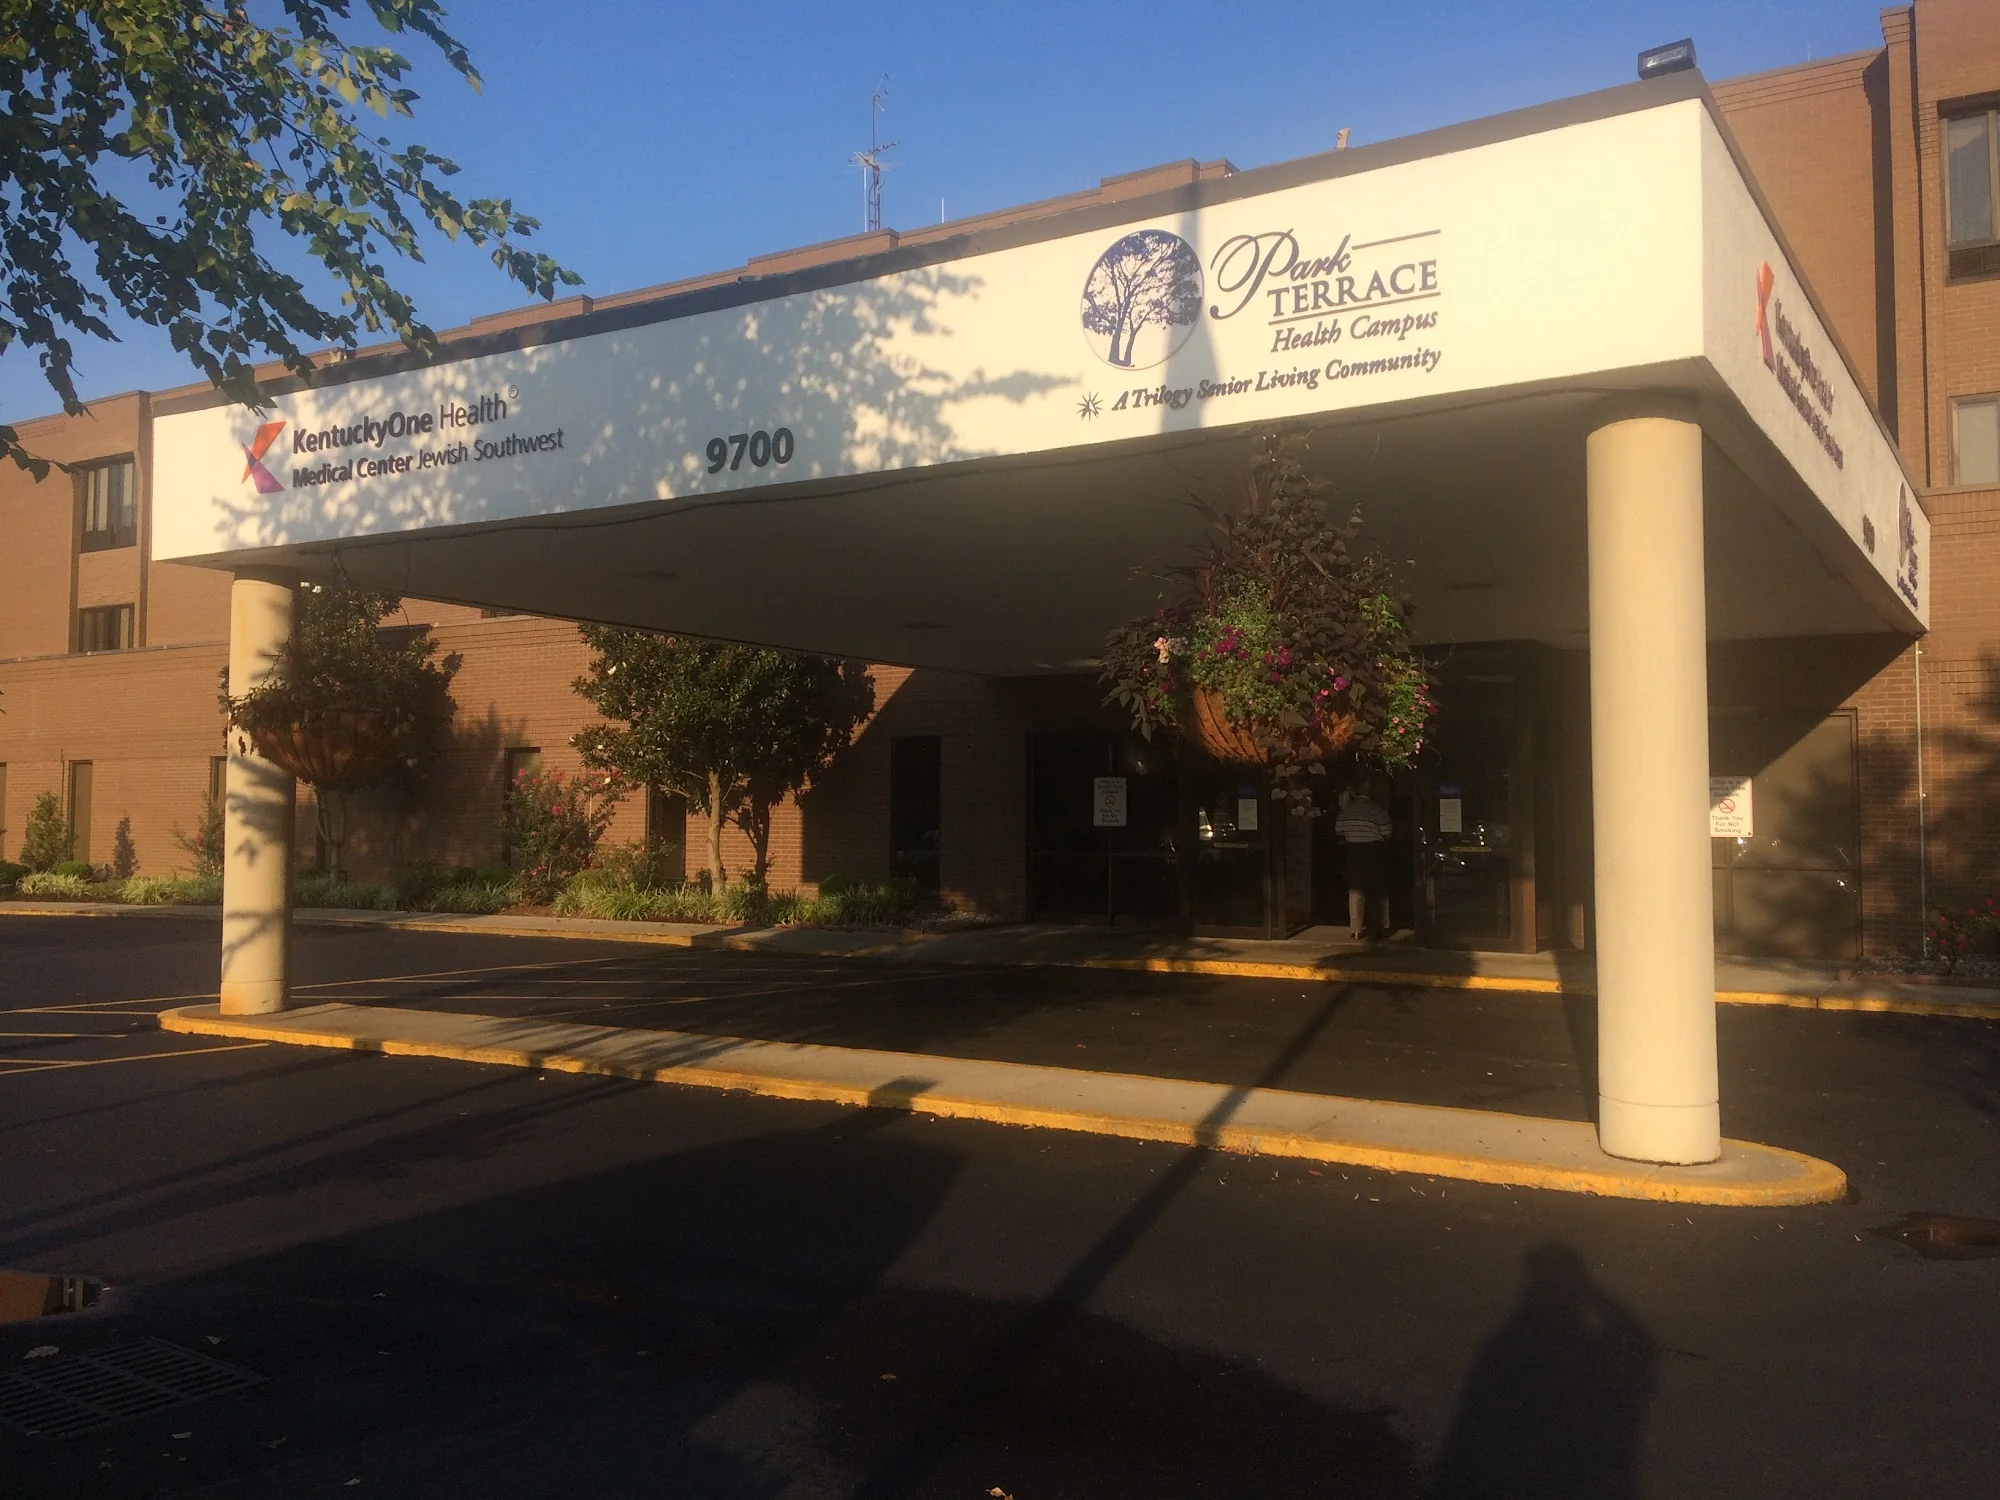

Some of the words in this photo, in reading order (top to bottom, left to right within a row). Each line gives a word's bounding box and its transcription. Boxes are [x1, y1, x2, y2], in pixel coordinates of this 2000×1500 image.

[1210, 228, 1352, 320] Park
[1267, 259, 1438, 317] TERRACE
[1270, 319, 1342, 353] Health
[1350, 310, 1439, 341] Campus
[1111, 391, 1129, 411] A
[1132, 385, 1193, 409] Trilogy
[1197, 377, 1252, 399] Senior
[1255, 368, 1321, 391] Living
[1325, 347, 1442, 380] Community
[292, 459, 353, 488] Medical
[357, 455, 414, 479] Center
[416, 441, 469, 470] Jewish
[474, 428, 565, 462] Southwest
[293, 411, 434, 454] KentuckyOne
[705, 427, 794, 475] 9700
